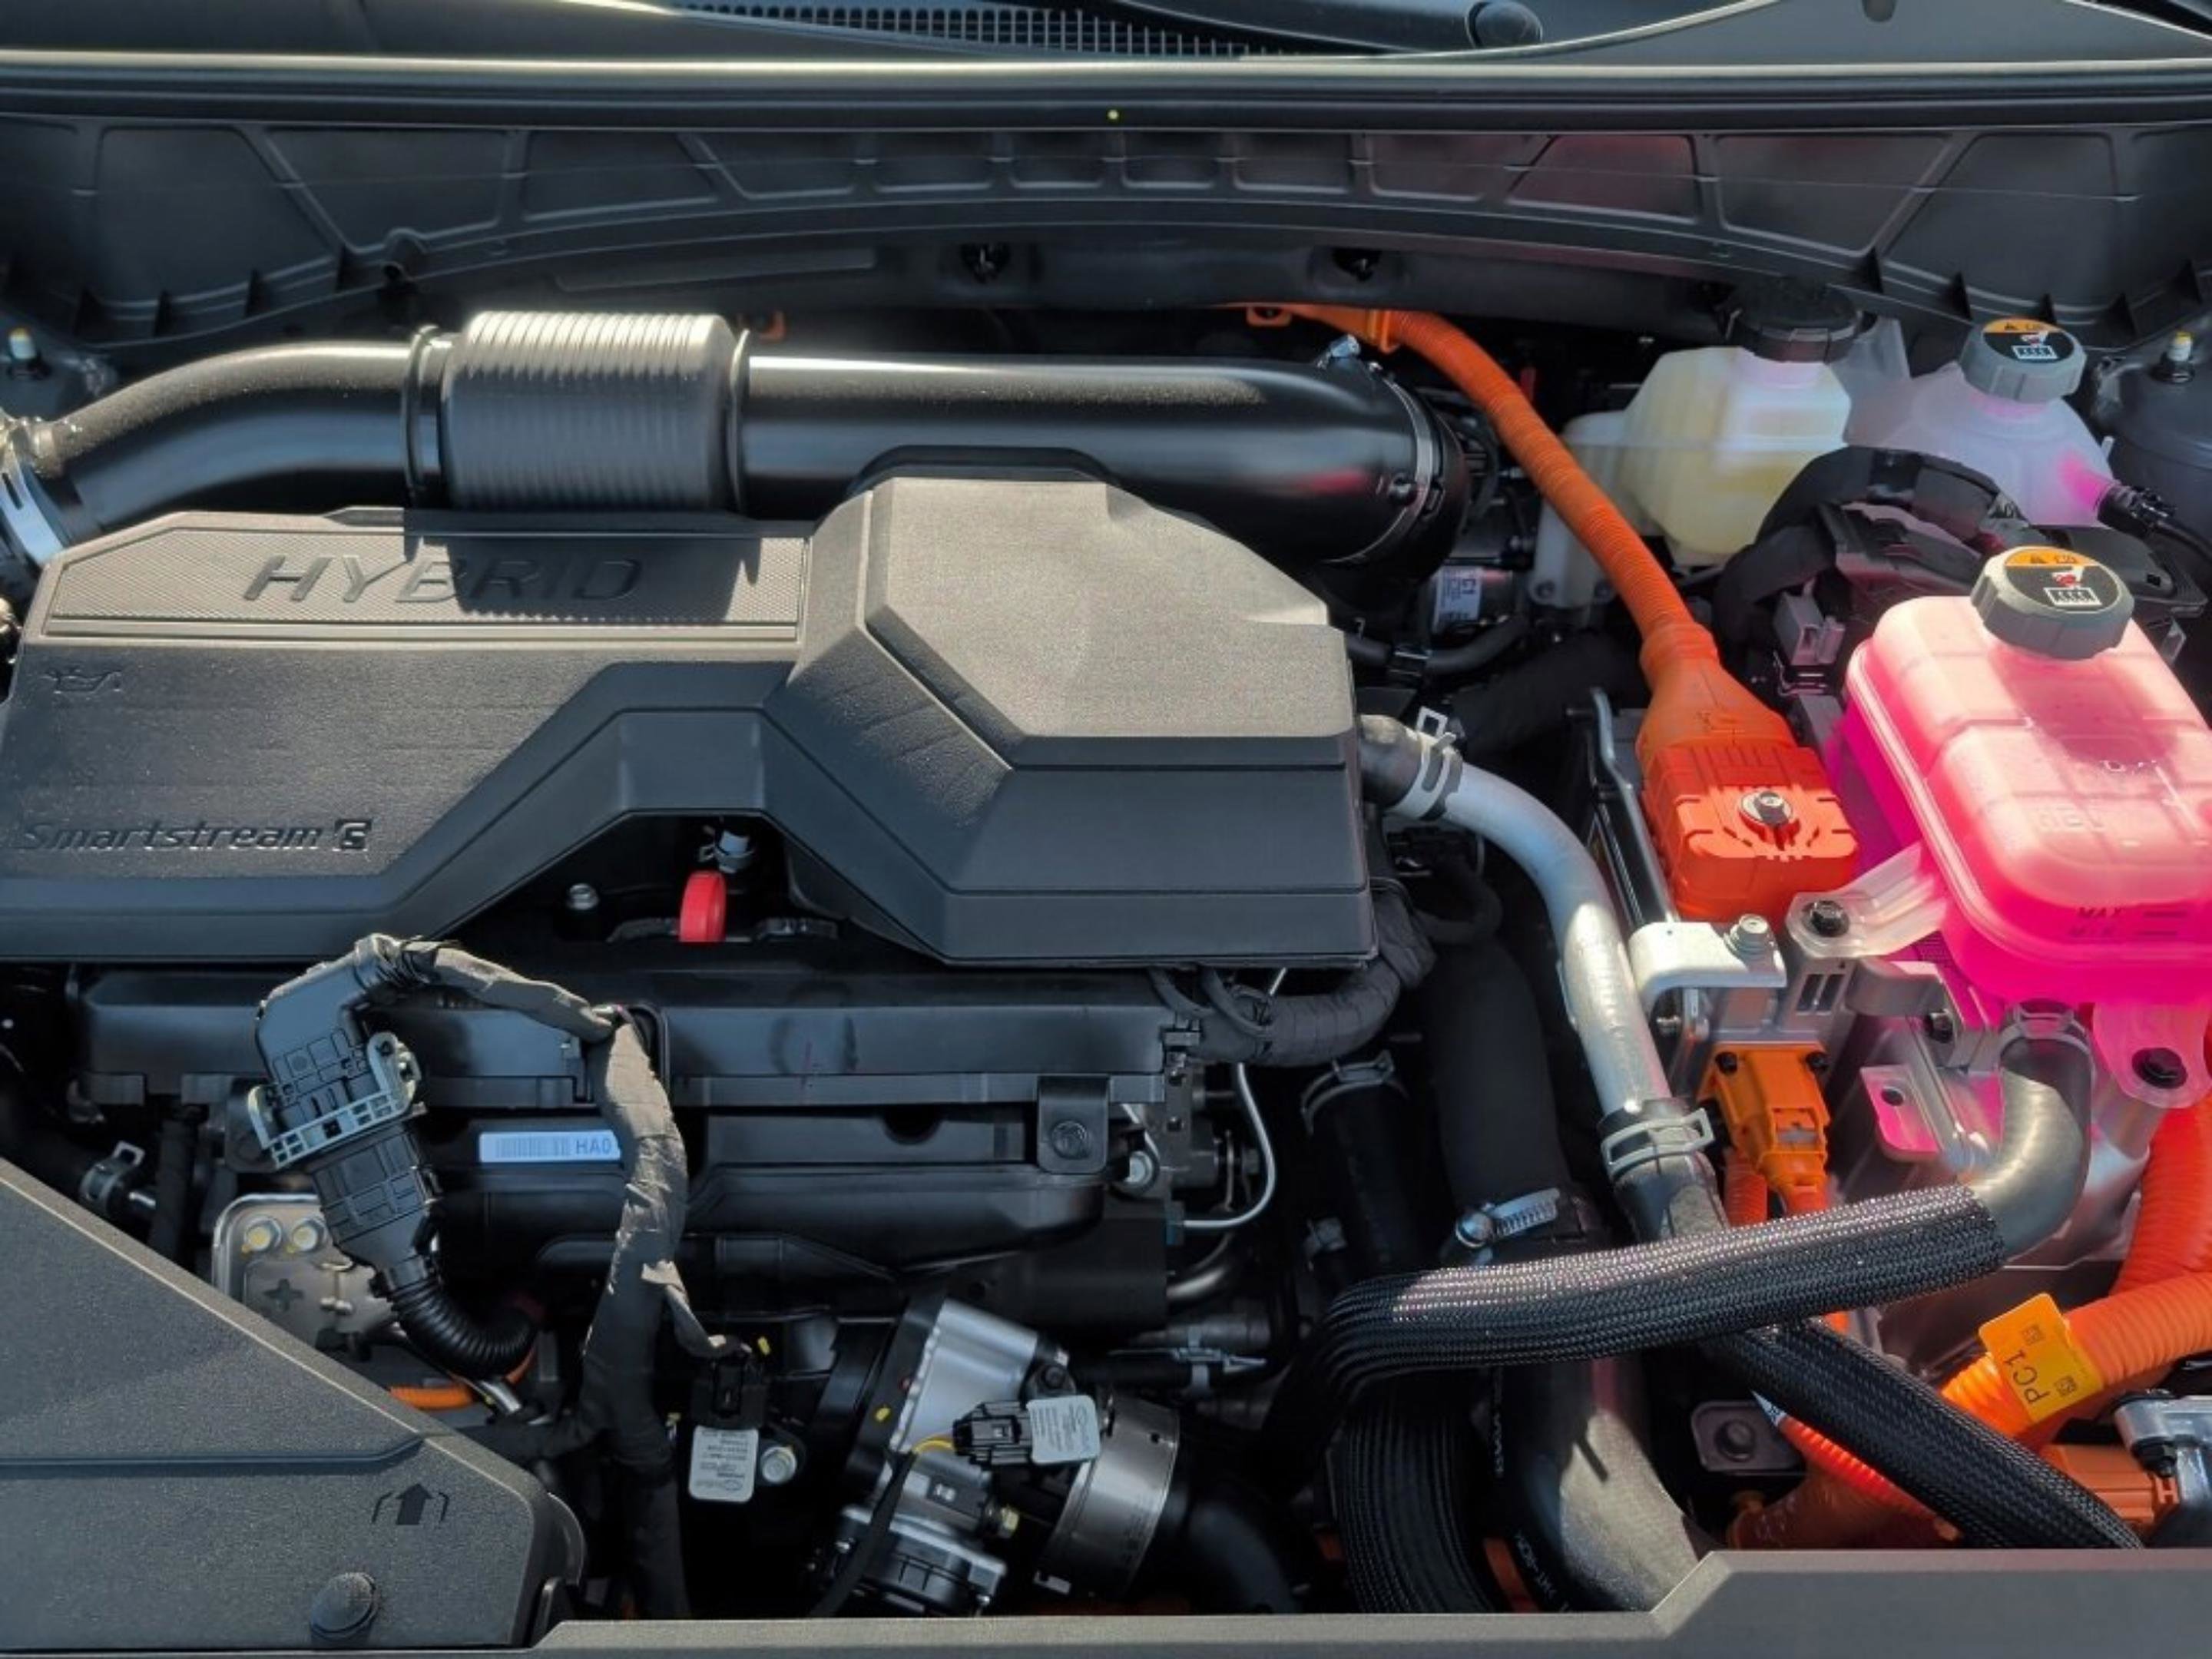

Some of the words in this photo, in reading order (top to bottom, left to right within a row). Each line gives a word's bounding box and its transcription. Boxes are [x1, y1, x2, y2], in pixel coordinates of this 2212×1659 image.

[243, 555, 643, 603] HYBRID
[22, 820, 323, 850] Smartstream
[2077, 906, 2125, 918] MAX
[2004, 1349, 2050, 1404] PC1
